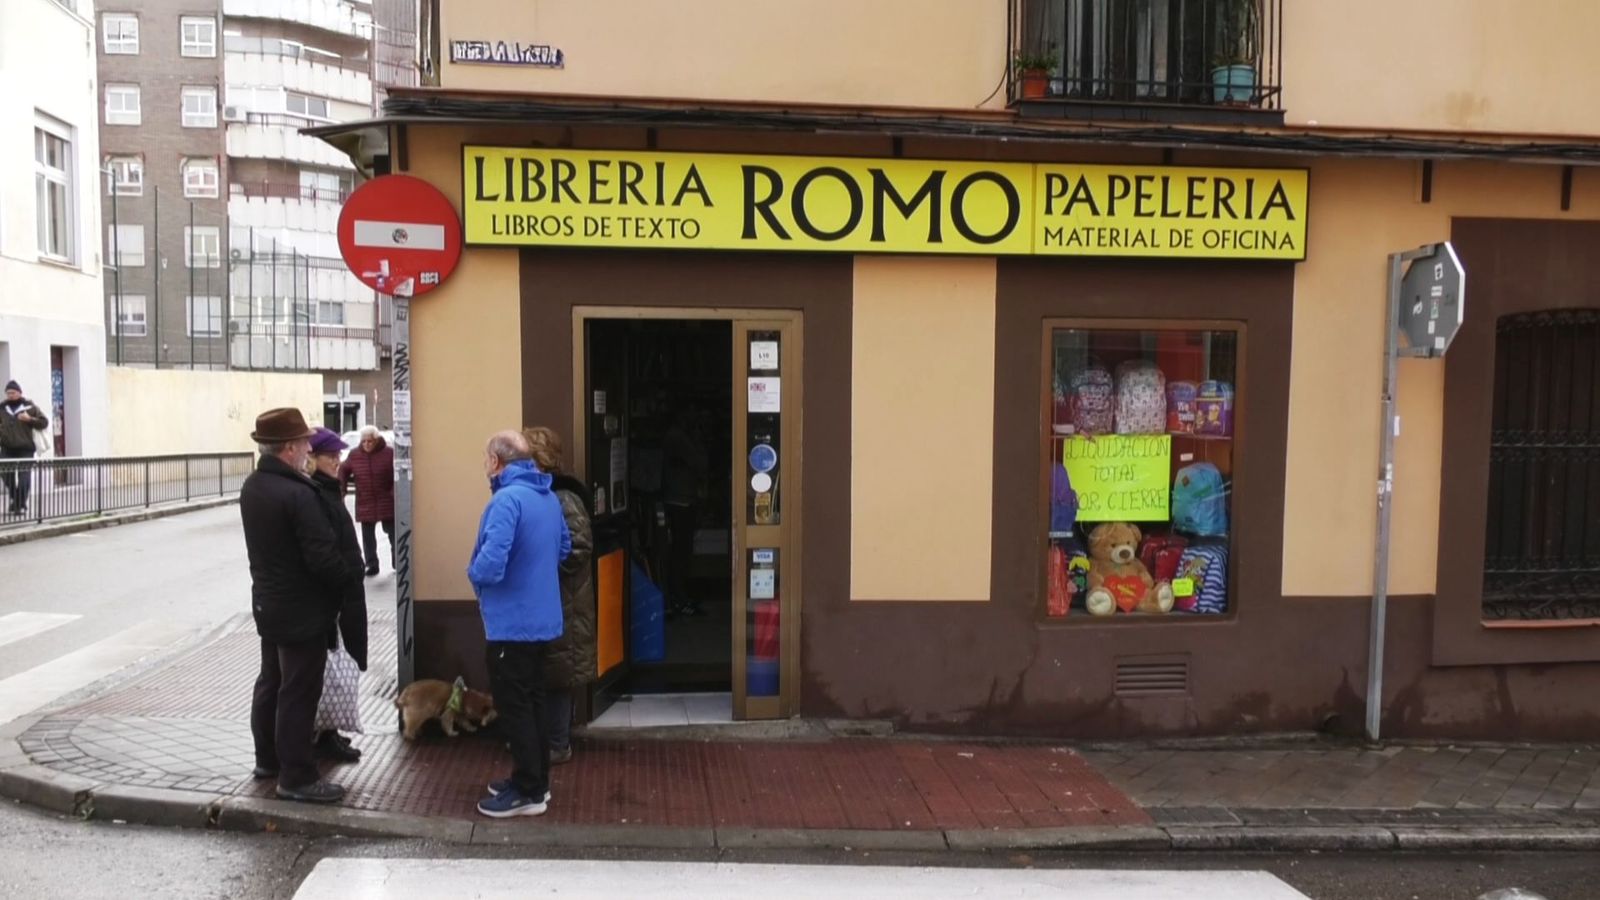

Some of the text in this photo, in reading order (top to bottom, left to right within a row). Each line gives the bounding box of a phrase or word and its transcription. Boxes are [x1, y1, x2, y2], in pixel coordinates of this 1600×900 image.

[474, 156, 714, 207] LIBRERIA
[1044, 173, 1296, 221] PAPELERIA
[741, 165, 1021, 244] ROMO
[491, 214, 701, 240] LIBROS DE TEXTO
[1044, 227, 1296, 250] MATERIAL DE OFICINA
[1078, 487, 1167, 512] OR CIERRE
